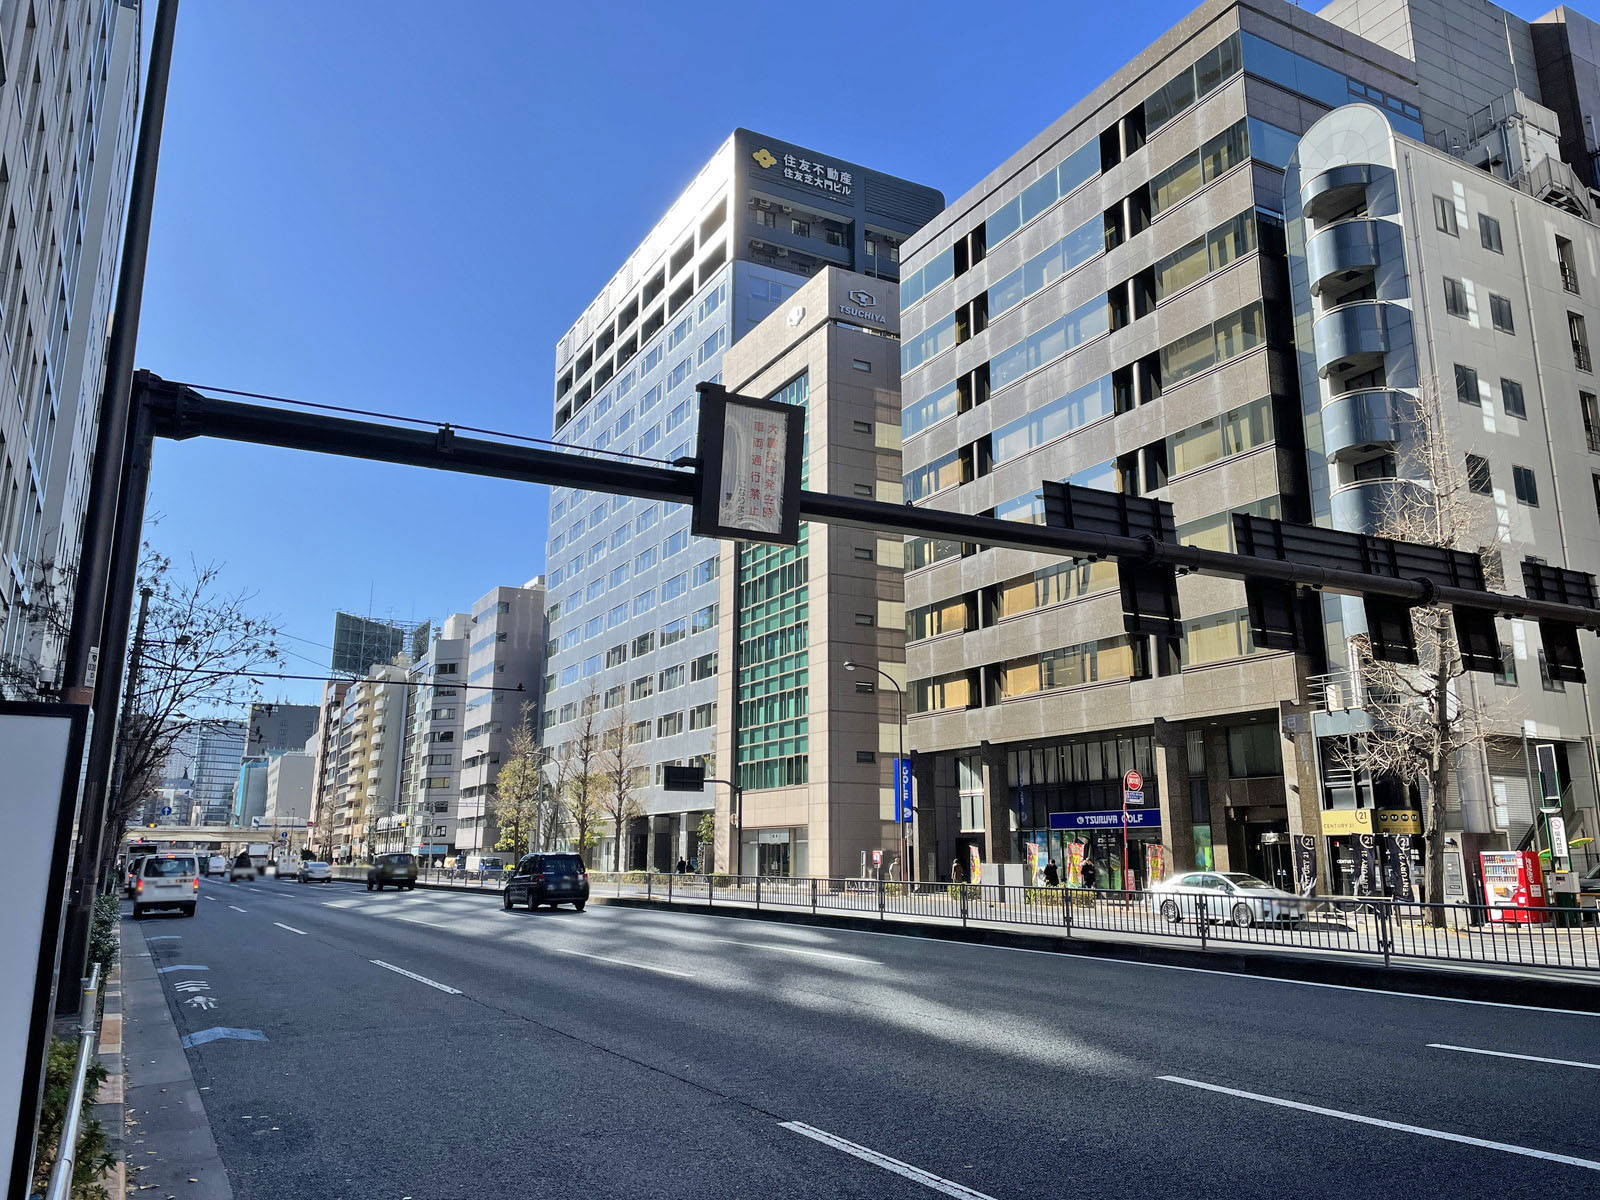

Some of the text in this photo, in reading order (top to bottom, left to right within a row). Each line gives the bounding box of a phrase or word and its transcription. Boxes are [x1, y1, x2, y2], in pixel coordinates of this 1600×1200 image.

[783, 154, 852, 185] 住友不動産
[783, 167, 851, 195] 住友芝大門ビル
[839, 304, 886, 323] TSUCHIYA
[749, 421, 765, 516] 車両通行禁止
[1358, 811, 1367, 820] 21
[1305, 838, 1314, 846] 21
[1364, 836, 1373, 845] 21
[1400, 860, 1409, 897] CENTURY
